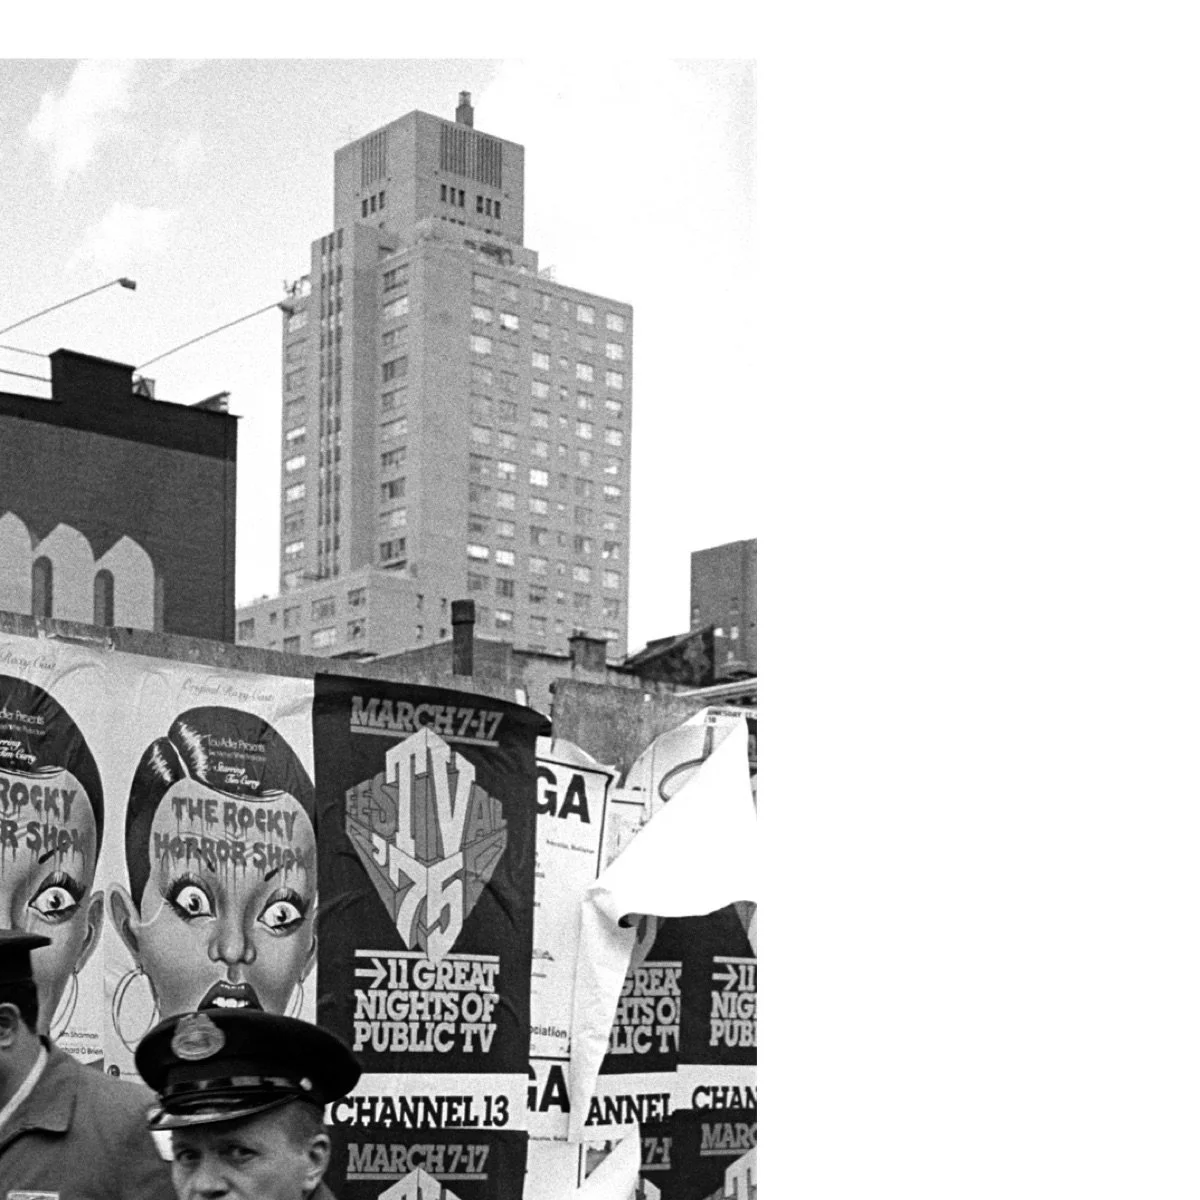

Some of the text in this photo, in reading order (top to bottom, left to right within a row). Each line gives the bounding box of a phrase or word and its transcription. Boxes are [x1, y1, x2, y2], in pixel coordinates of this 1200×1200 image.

[350, 695, 504, 741] MARCH 7-17
[172, 797, 298, 840] THE ROCKY
[154, 832, 246, 868] HORROR
[387, 959, 500, 992] 11 GREAT
[354, 989, 500, 1022] NIGHTS OF
[710, 991, 757, 1019] NIG
[353, 1021, 497, 1053] PUBLIC TV
[710, 1019, 757, 1047] PUB
[330, 1094, 509, 1129] CHANNEL 13
[347, 1143, 490, 1173] MARCH 7-17
